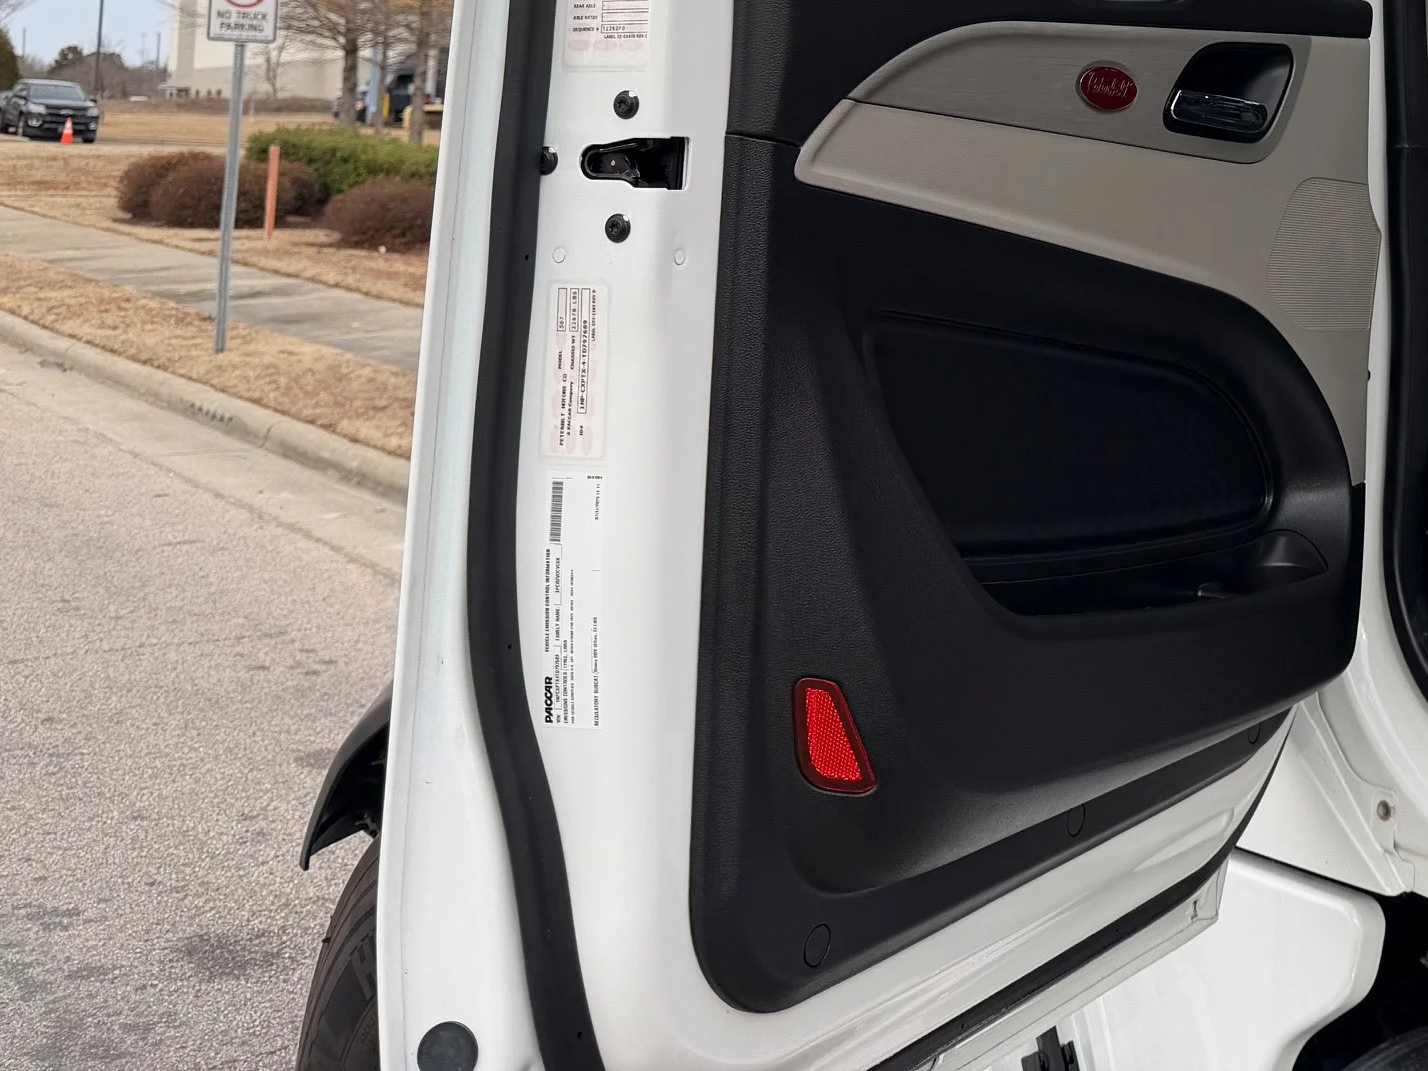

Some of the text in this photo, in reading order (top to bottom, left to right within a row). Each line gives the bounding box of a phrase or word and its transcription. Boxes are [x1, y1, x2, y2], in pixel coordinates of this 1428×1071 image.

[216, 9, 268, 21] NO TRUCK
[220, 21, 265, 33] PARKING
[544, 676, 554, 724] PACCAR
